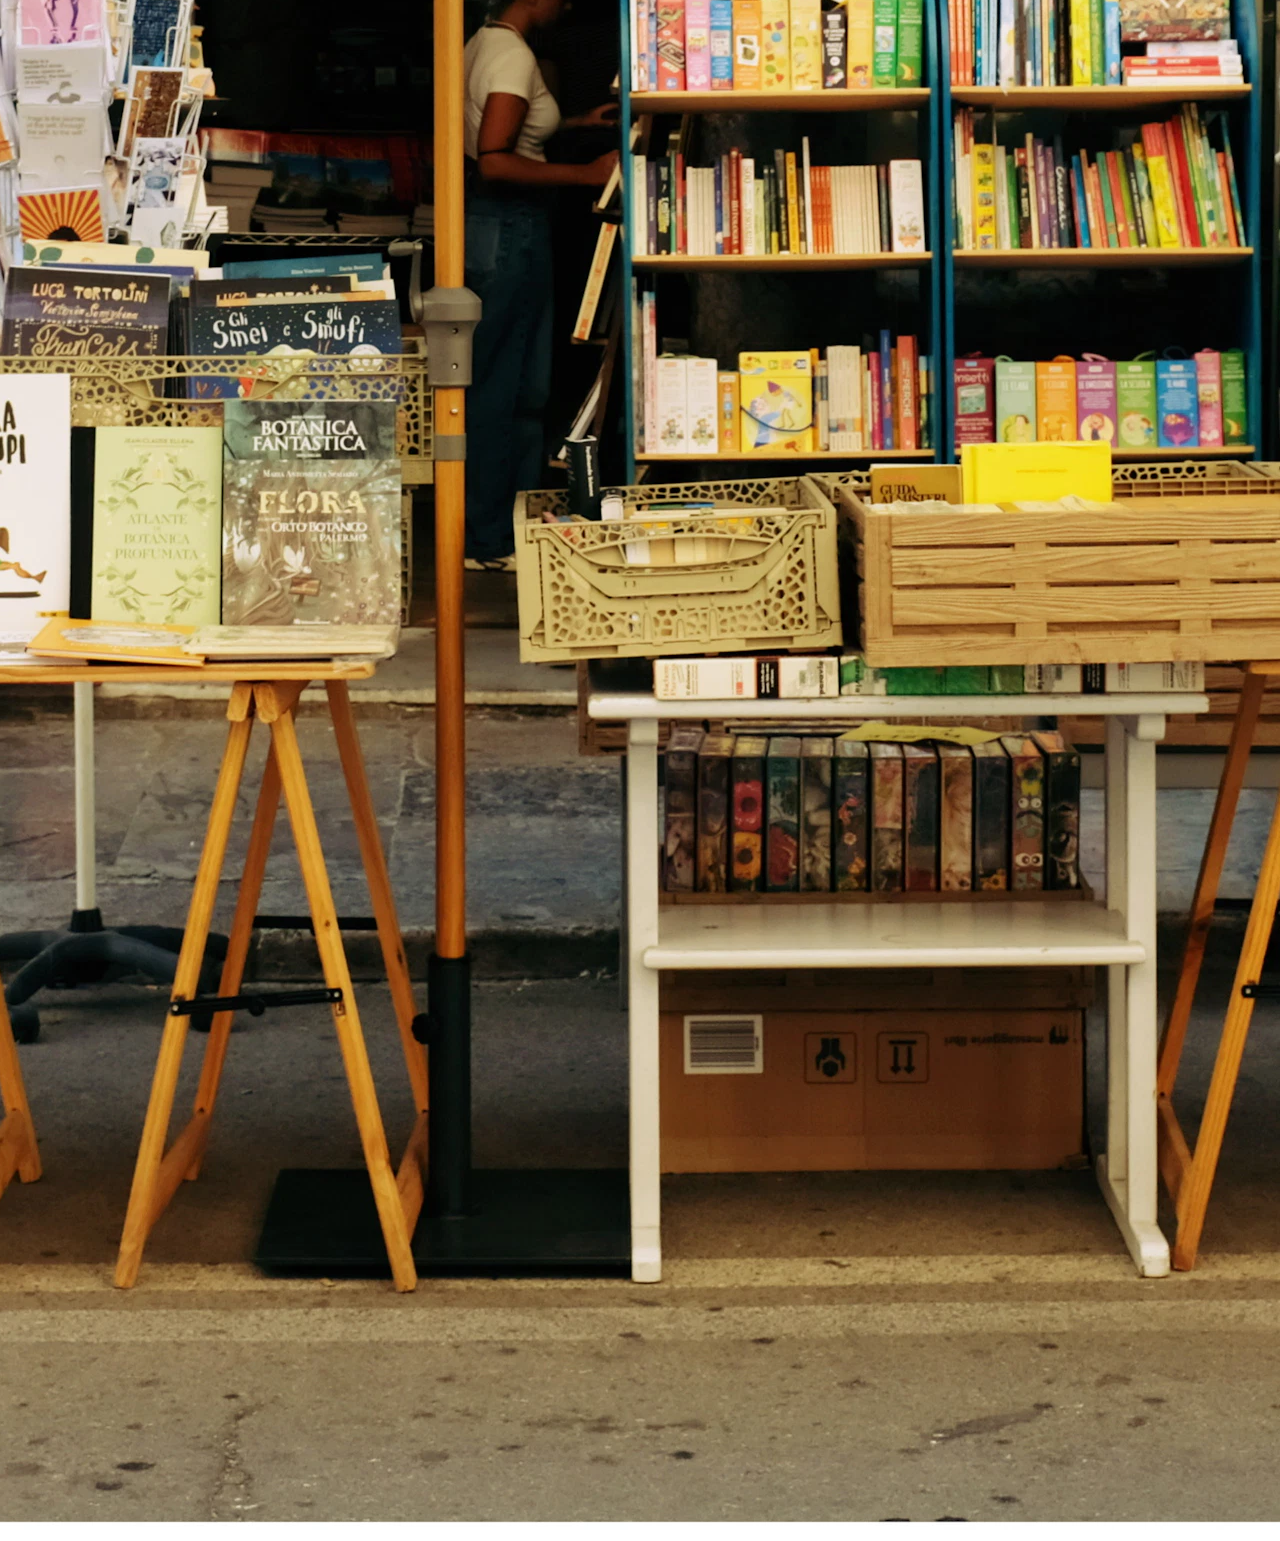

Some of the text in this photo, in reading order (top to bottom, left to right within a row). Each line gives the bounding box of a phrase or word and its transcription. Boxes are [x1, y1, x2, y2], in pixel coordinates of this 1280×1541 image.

[228, 305, 343, 327] Gli gli
[212, 319, 269, 350] Smei
[301, 309, 367, 344] Smufi
[260, 419, 359, 436] BOTANICA
[252, 435, 367, 451] FANTASTICA
[879, 484, 917, 495] GUIDA
[257, 490, 367, 514] FLORA
[127, 513, 188, 525] ATLANTE
[271, 521, 368, 533] ORTO BOTANICO
[123, 533, 191, 545] BOTANICA
[319, 534, 368, 543] PALERMO
[115, 548, 199, 560] PROFUMATA
